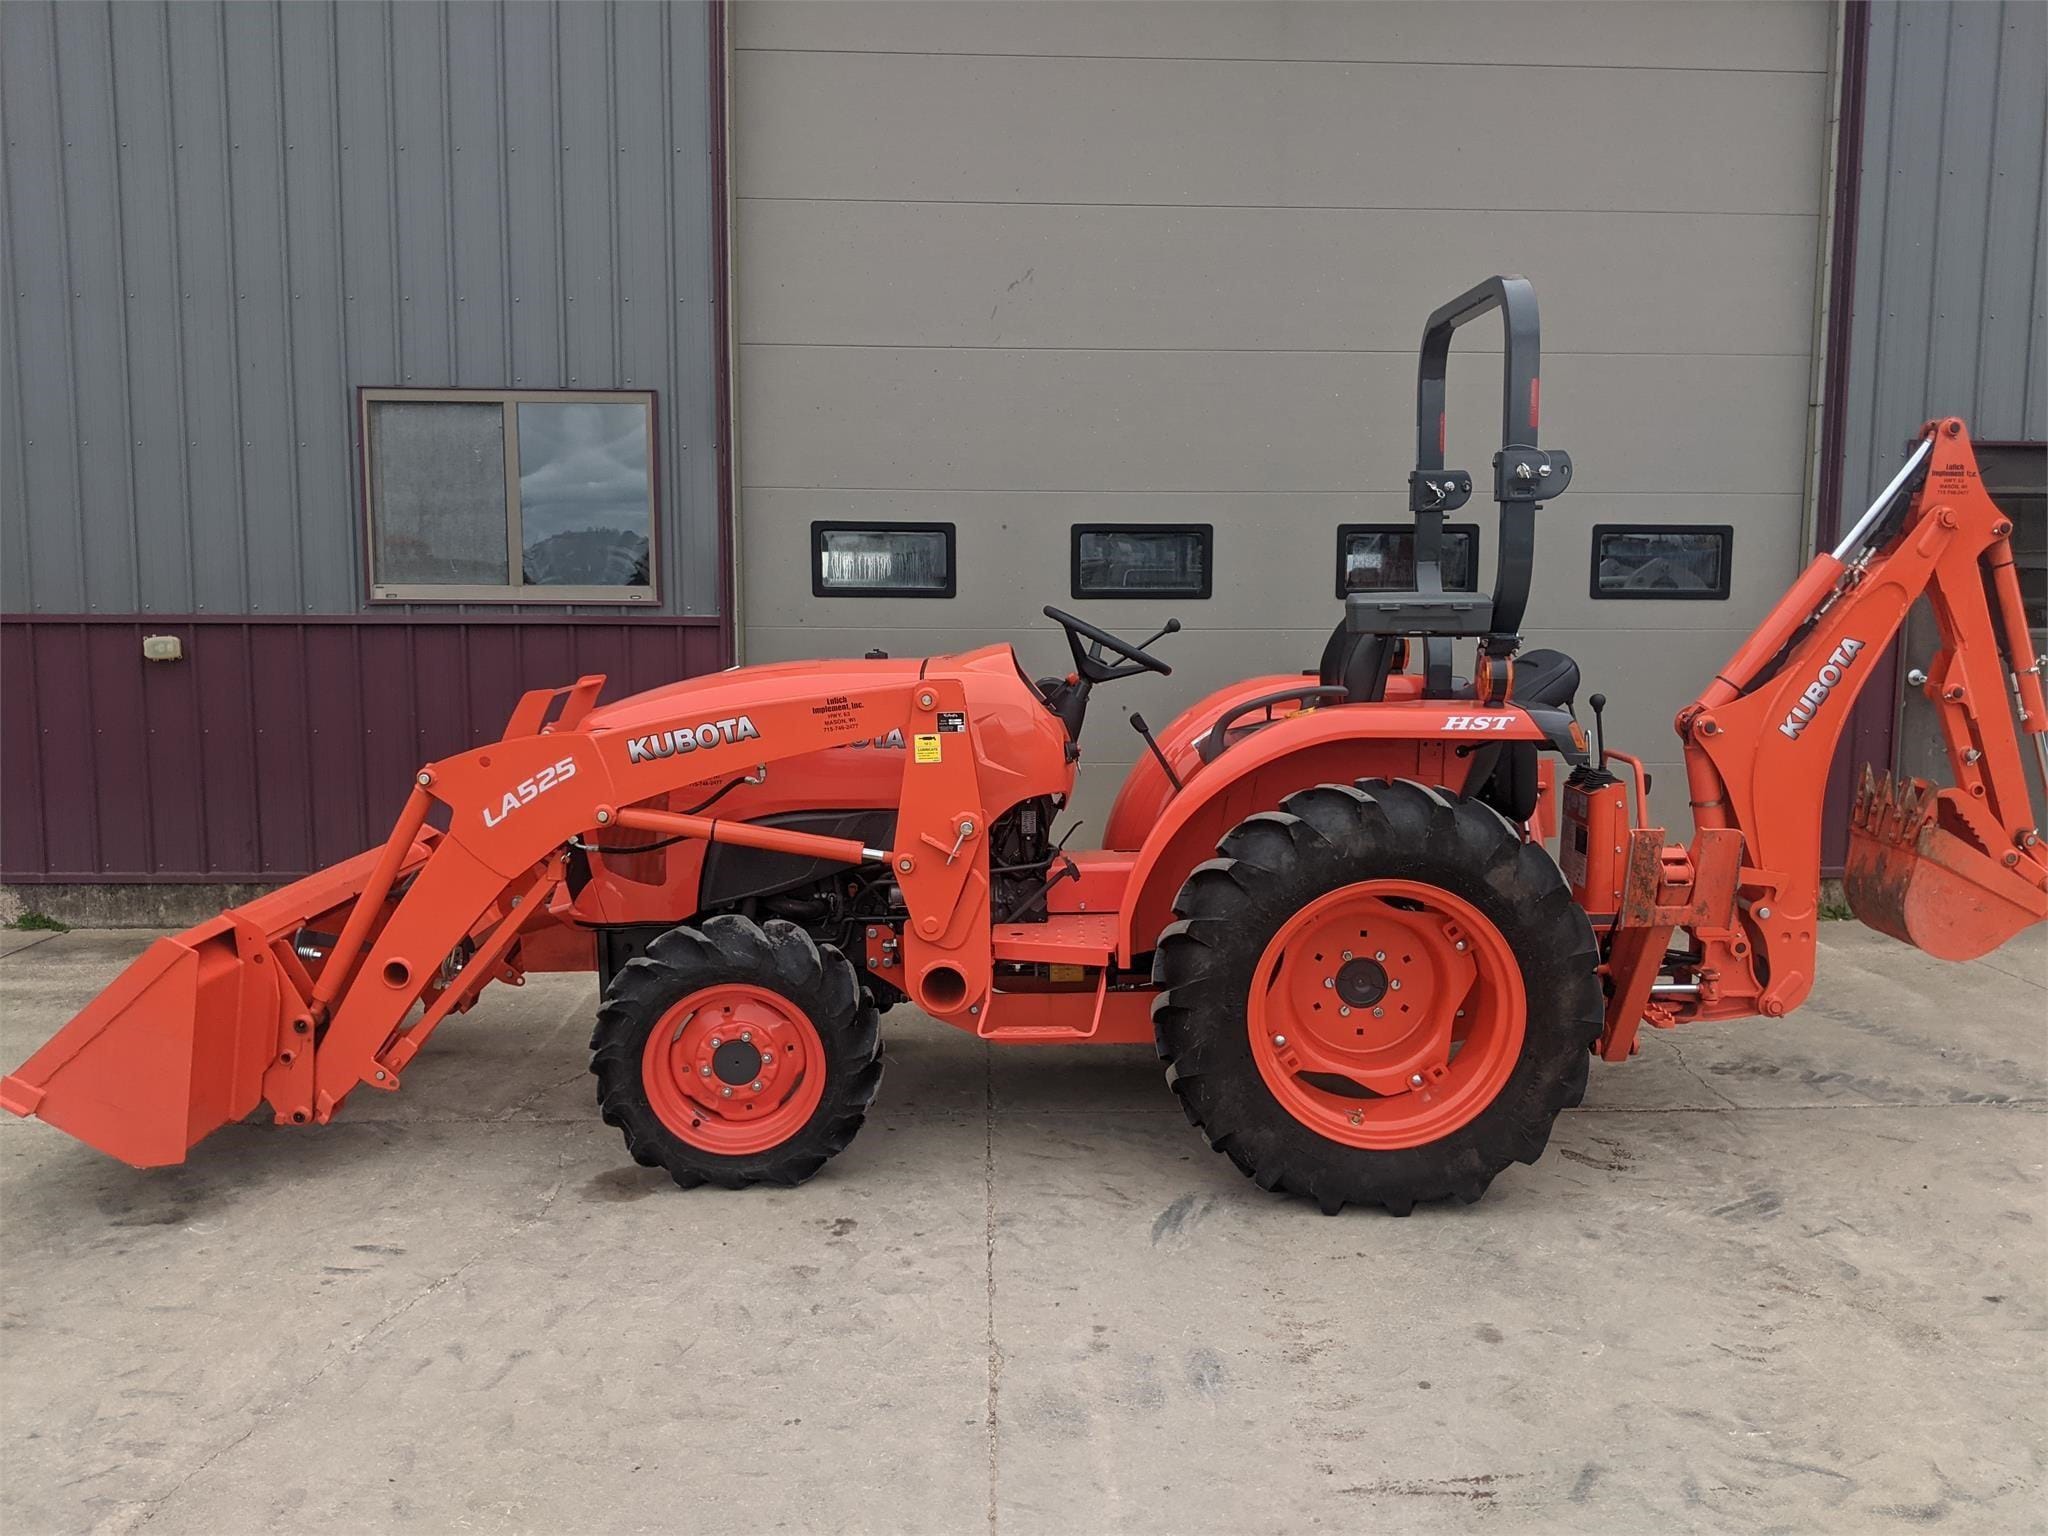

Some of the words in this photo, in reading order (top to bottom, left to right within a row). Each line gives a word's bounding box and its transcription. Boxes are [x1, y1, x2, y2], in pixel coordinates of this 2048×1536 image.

[1778, 637, 1866, 741] KUBOTA
[626, 715, 760, 764] KUBOTA
[1440, 716, 1516, 731] HST
[482, 756, 577, 828] LA525
